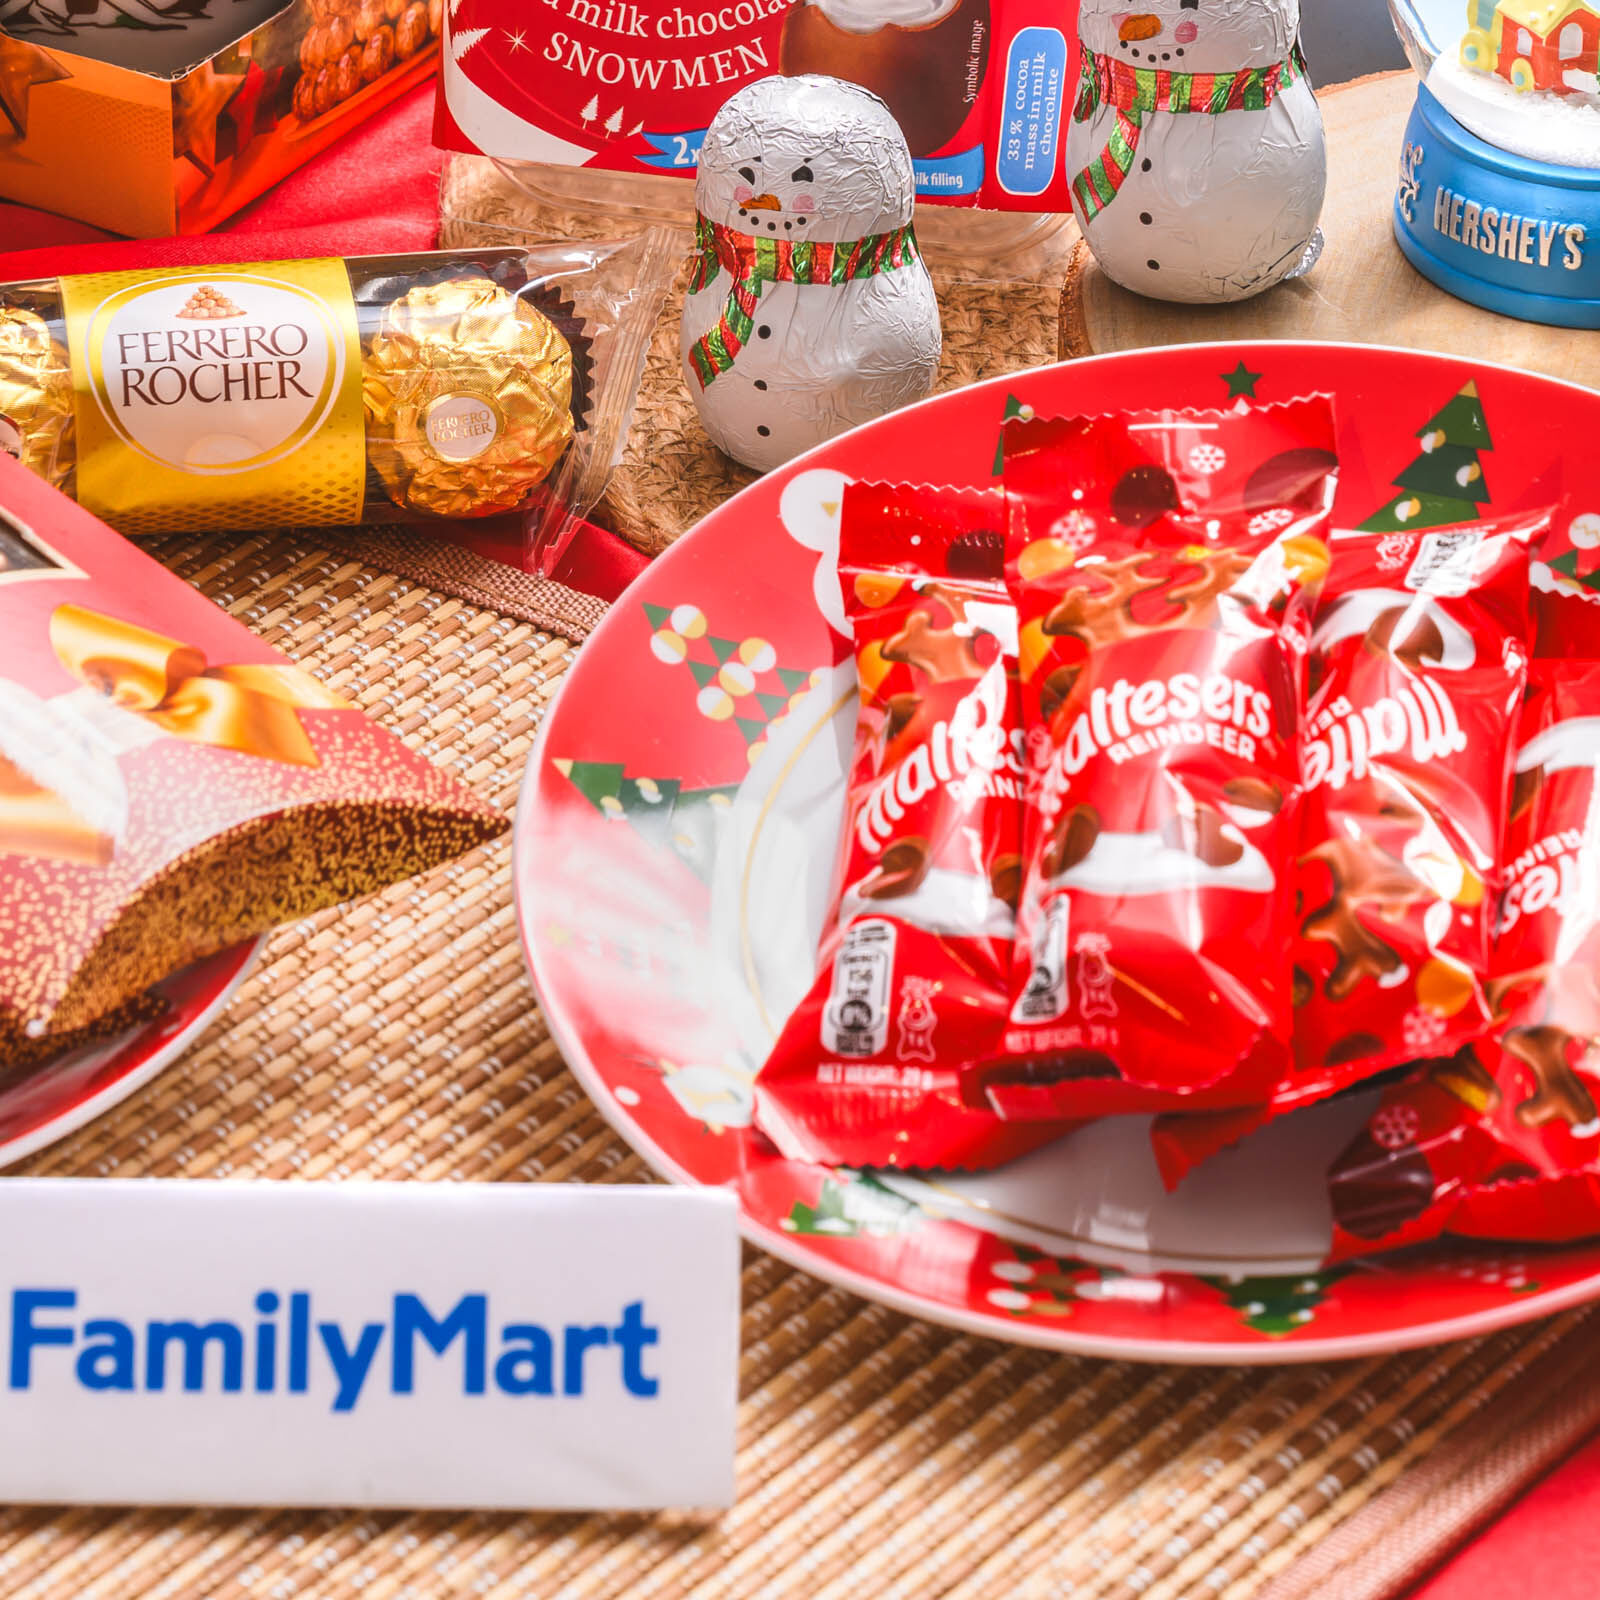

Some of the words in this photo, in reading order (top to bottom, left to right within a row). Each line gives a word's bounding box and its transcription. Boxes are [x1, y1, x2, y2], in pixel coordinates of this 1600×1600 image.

[543, 31, 770, 90] SNOWMEN
[962, 55, 982, 103] Symbolic
[972, 19, 987, 54] image
[1016, 58, 1030, 110] cocoa
[1031, 51, 1047, 102] milk
[1010, 119, 1023, 135] %
[1027, 105, 1041, 119] in
[1041, 67, 1060, 155] chocolate
[1008, 138, 1021, 160] 33
[1025, 132, 1038, 170] mass
[913, 171, 928, 187] ilk
[931, 170, 964, 188] filling
[1432, 189, 1585, 271] HERSHEY'S
[118, 323, 309, 367] FERRERO
[121, 360, 314, 408] ROCHER
[1107, 722, 1256, 764] REINDEER
[9, 1287, 658, 1414] FamilyMart
